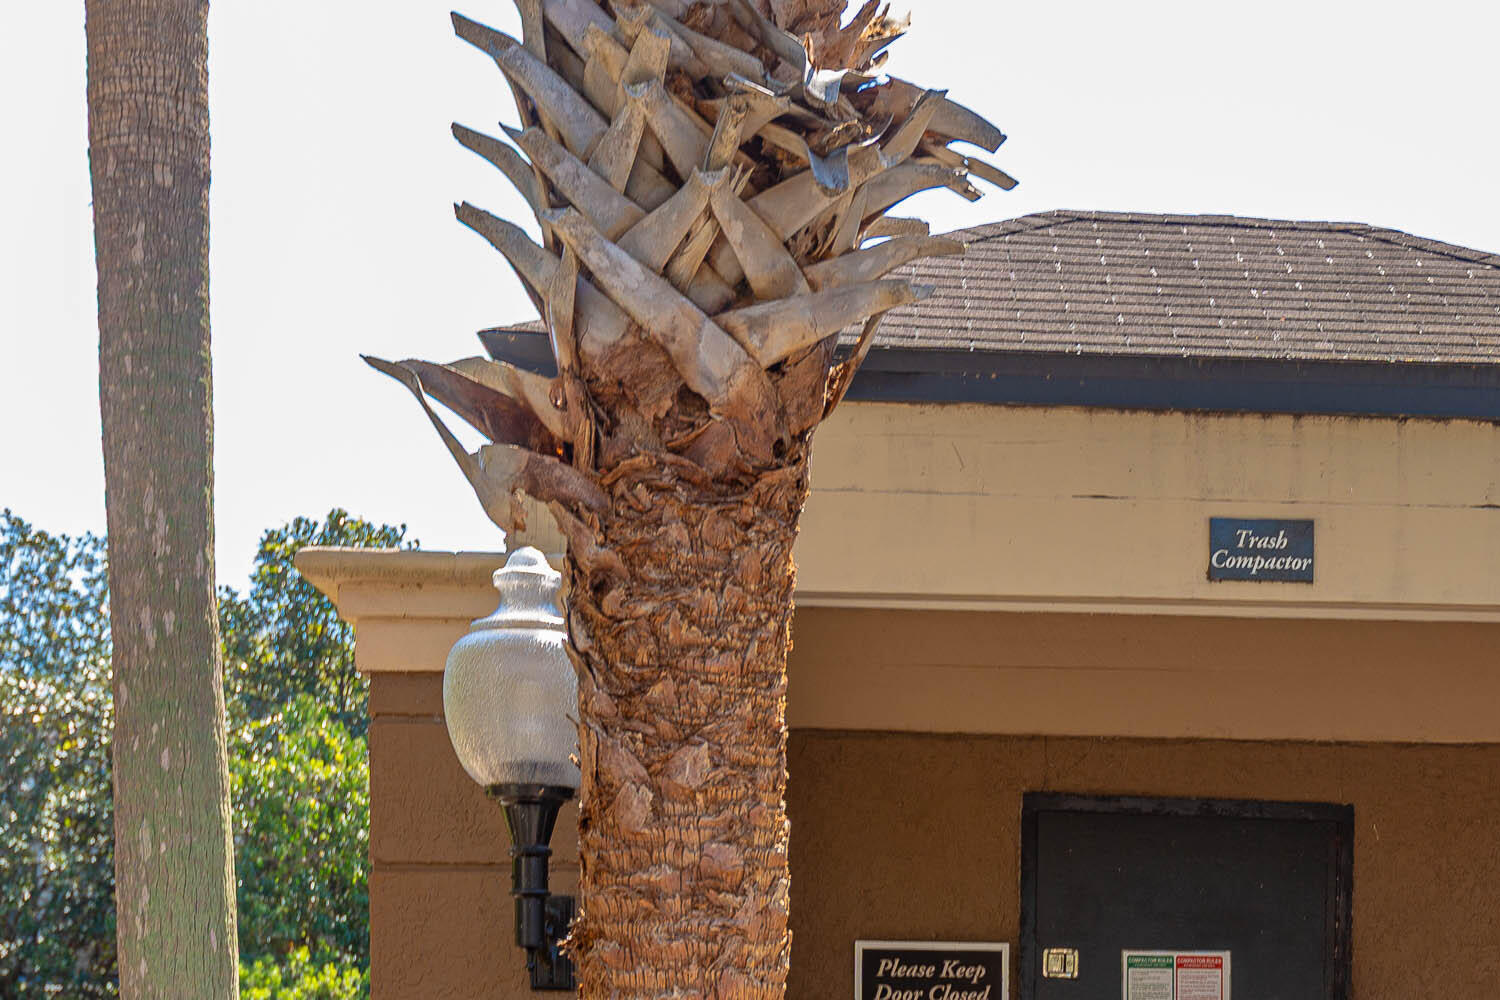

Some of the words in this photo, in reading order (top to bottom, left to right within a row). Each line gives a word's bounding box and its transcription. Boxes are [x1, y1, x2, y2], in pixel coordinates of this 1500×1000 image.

[1236, 529, 1288, 549] Trash
[1211, 549, 1312, 575] Compactor
[876, 958, 935, 978] Please
[939, 959, 986, 984] Keep
